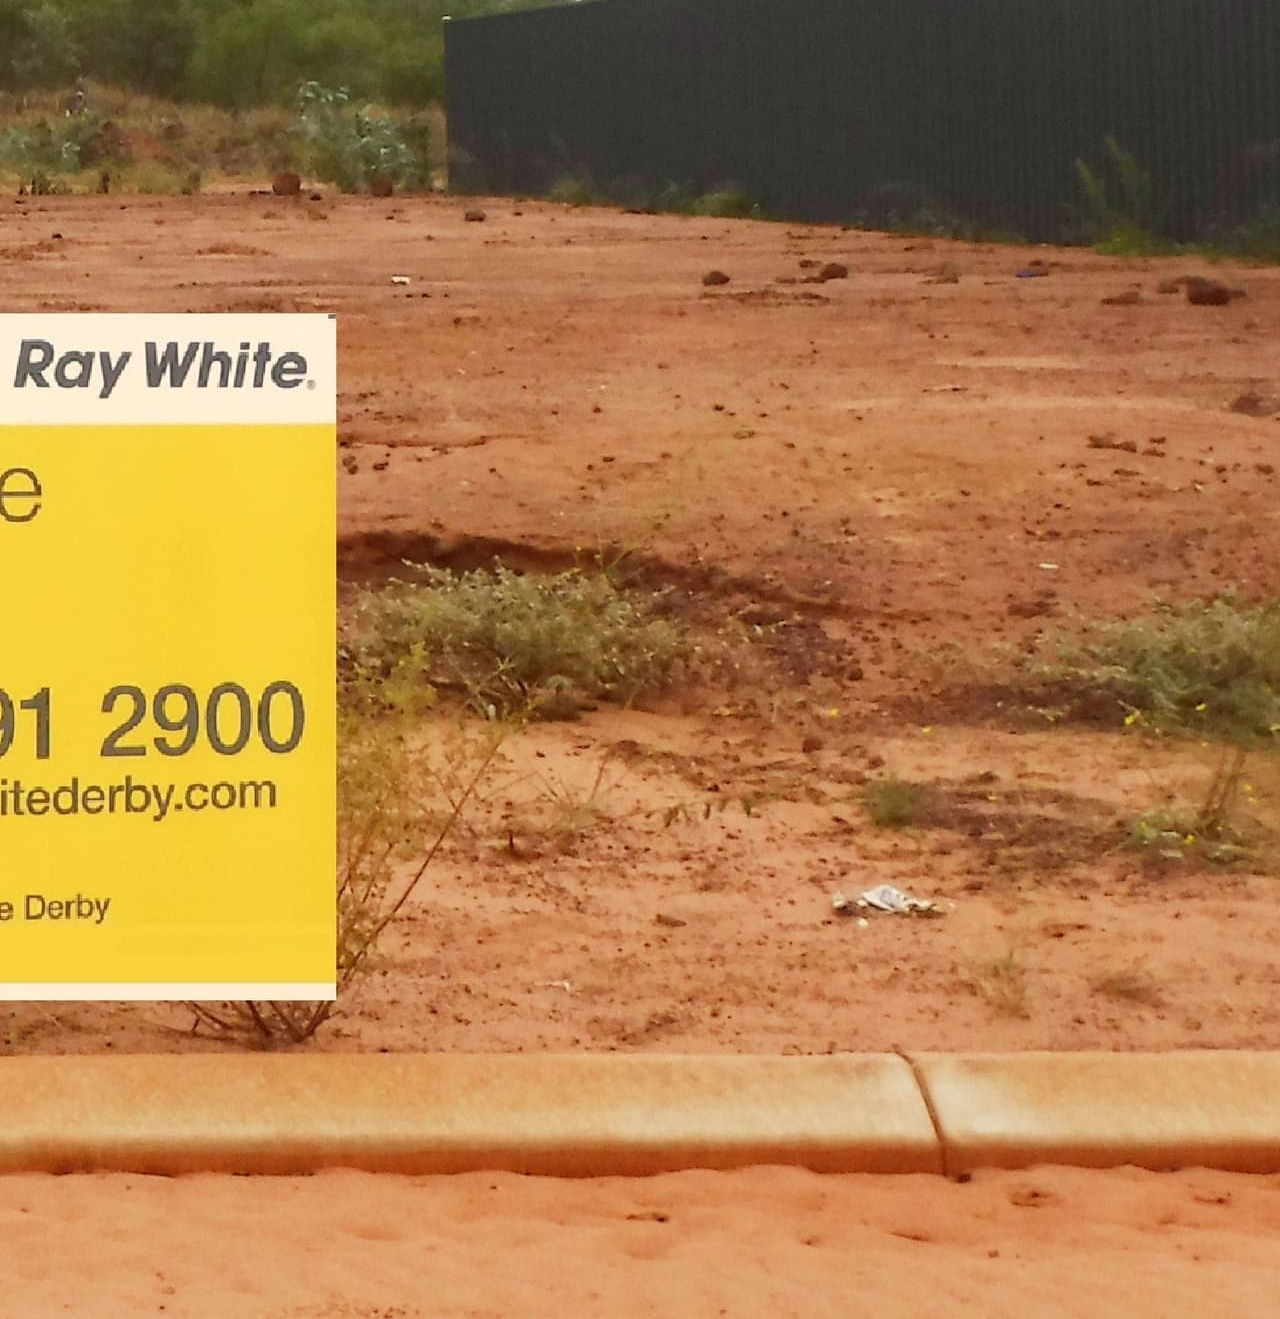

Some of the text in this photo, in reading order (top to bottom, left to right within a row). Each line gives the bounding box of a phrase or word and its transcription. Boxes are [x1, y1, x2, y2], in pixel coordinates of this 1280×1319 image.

[14, 339, 132, 399] Ray
[101, 681, 305, 756] 2900
[26, 894, 110, 924] Derby
